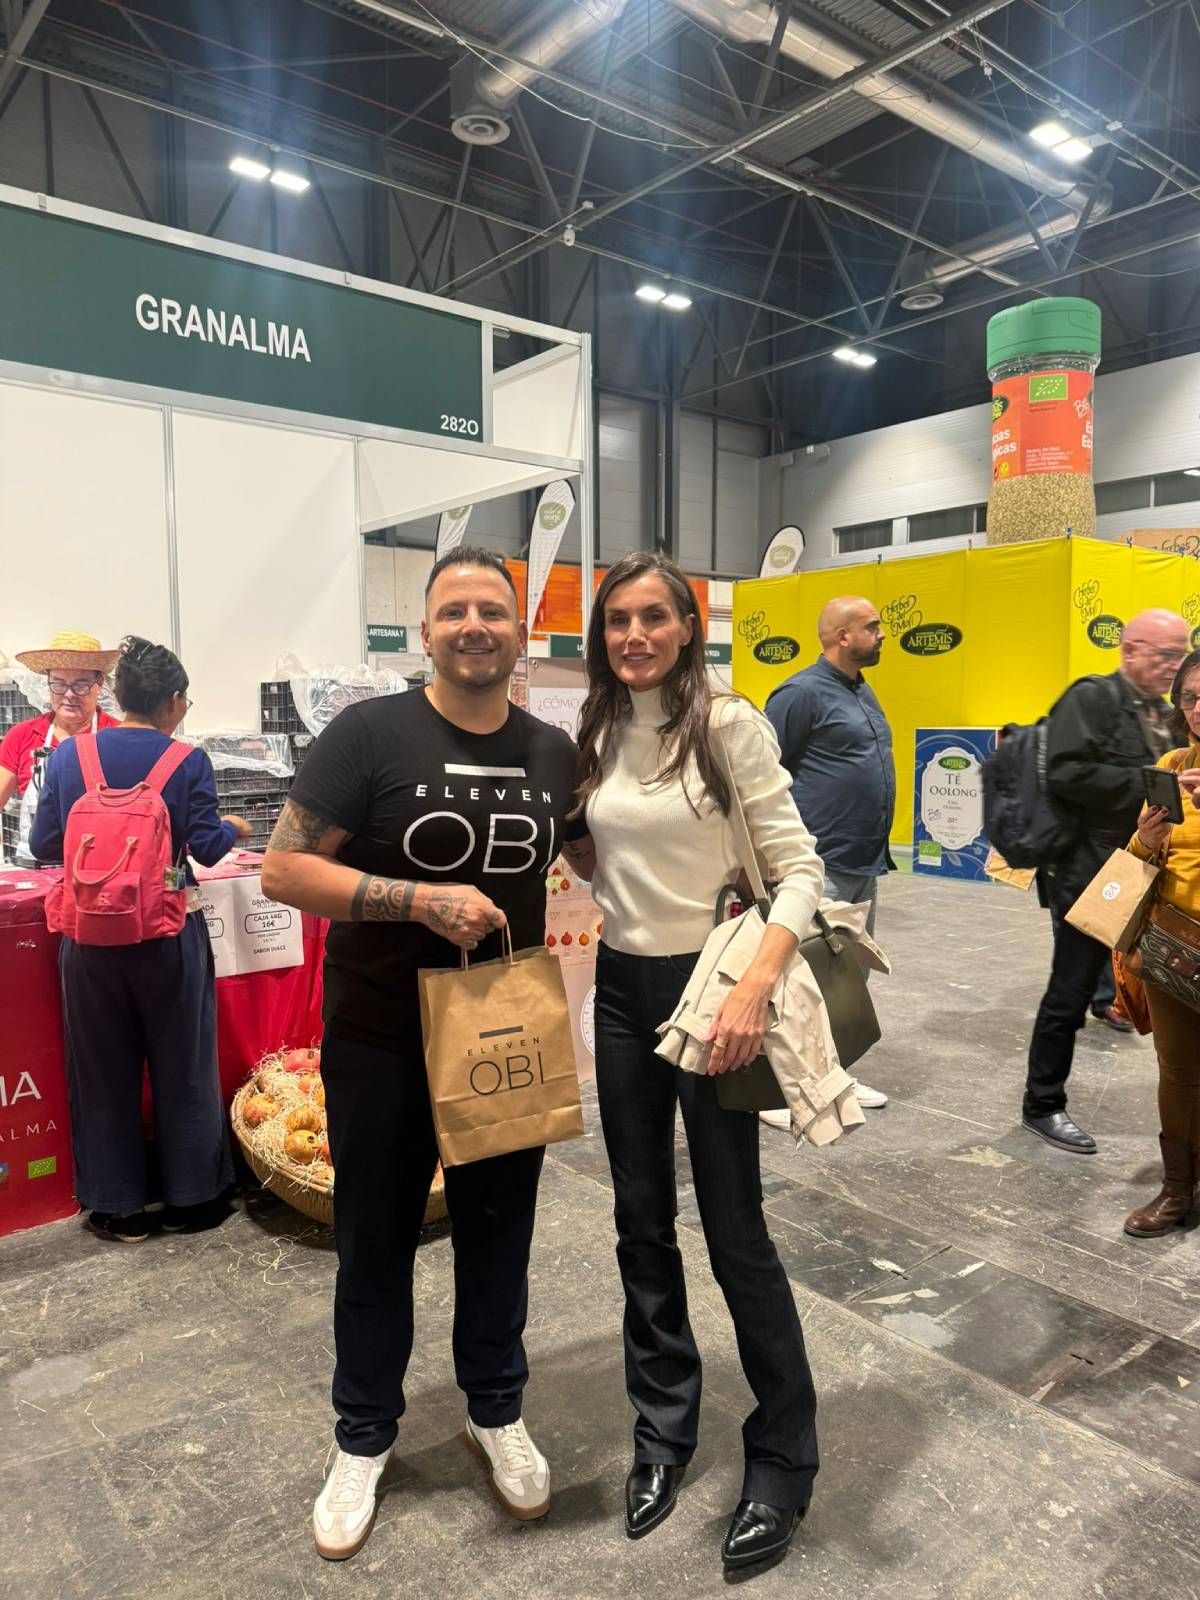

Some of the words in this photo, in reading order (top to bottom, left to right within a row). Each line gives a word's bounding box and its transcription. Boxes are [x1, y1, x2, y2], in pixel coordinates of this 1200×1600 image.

[136, 293, 311, 362] GRANALMA
[907, 631, 953, 647] ARTEMIS
[759, 645, 793, 657] ARTEMIS
[945, 773, 962, 785] TÉ
[415, 784, 552, 803] ELEVEN
[402, 811, 555, 874] OBI
[467, 1037, 540, 1057] ELEVEN
[470, 1051, 544, 1096] OBI
